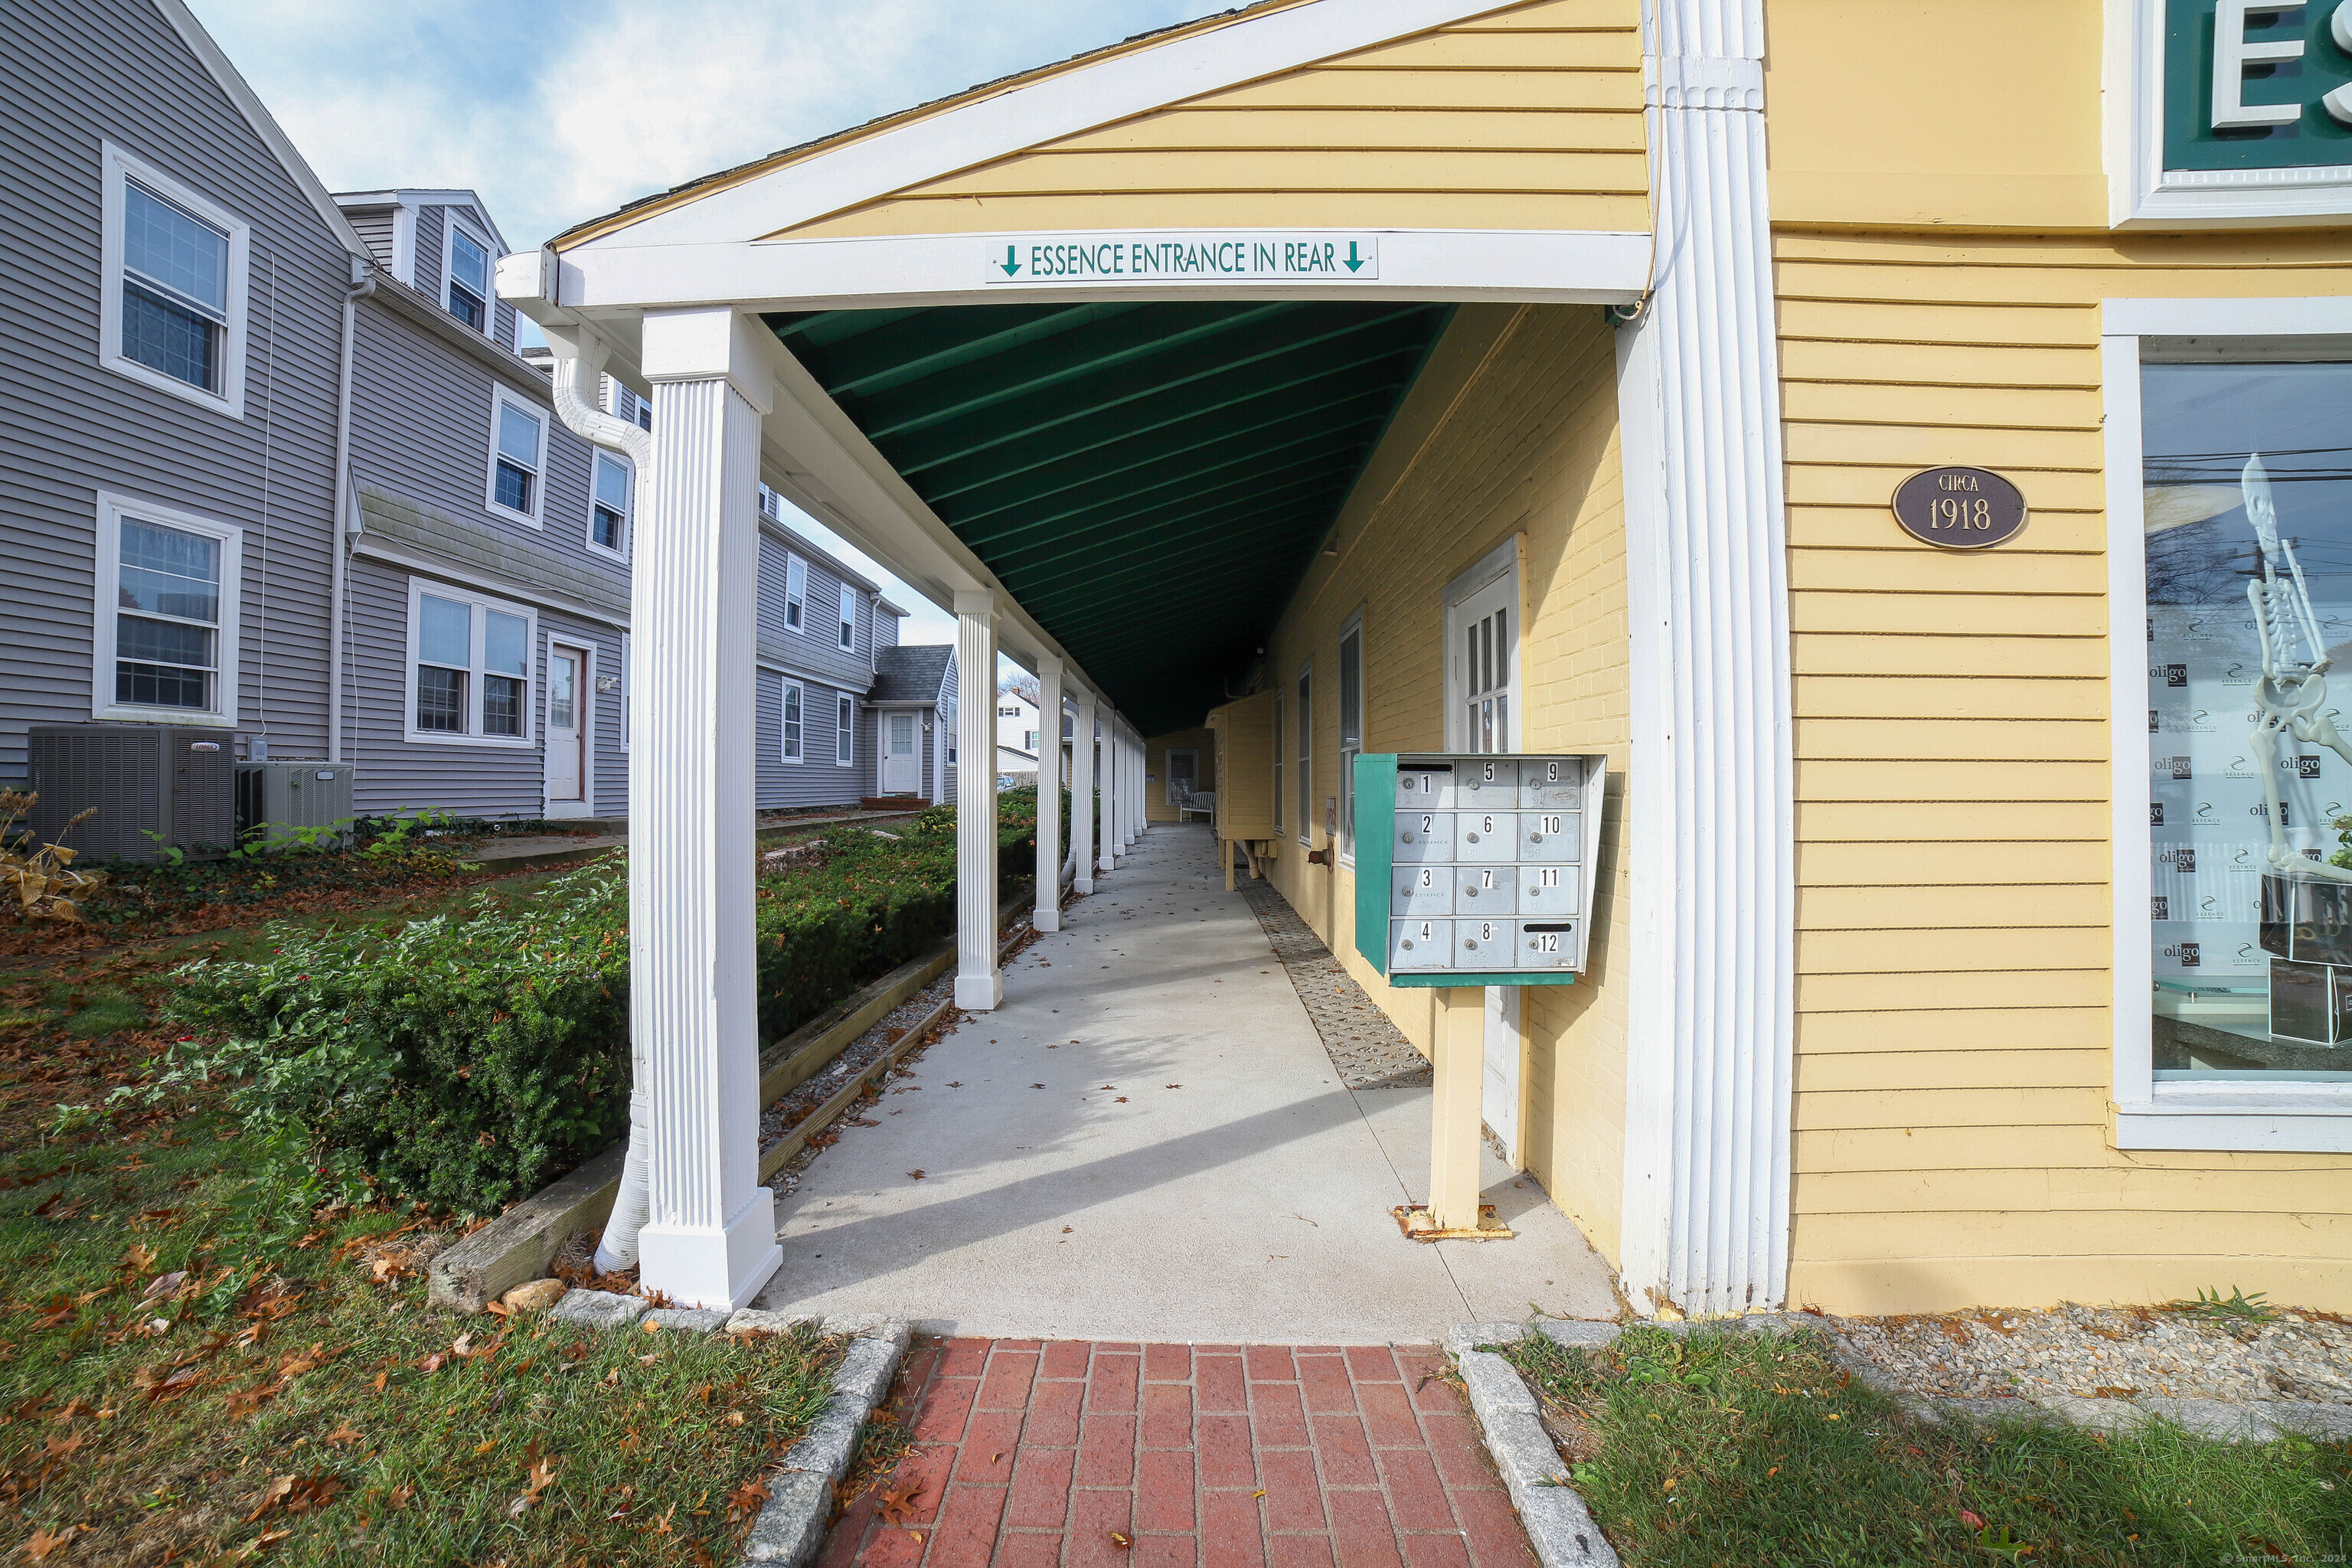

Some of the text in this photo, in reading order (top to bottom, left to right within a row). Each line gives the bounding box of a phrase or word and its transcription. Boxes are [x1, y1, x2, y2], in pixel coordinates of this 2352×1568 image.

[1031, 241, 1337, 276] ESSENCE ENTRANCE IN REAR
[1939, 474, 1979, 492] CIRCA
[1930, 498, 1991, 531] 1918
[2149, 665, 2187, 683] oligo
[1485, 763, 1493, 781] 5
[1549, 763, 1557, 781] 9
[2154, 757, 2191, 775] oligo
[2280, 756, 2320, 774] oligo
[1423, 775, 1429, 793] 1
[1423, 815, 1431, 833] 2
[1484, 815, 1492, 833] 6
[1544, 816, 1560, 834] 10
[2159, 851, 2196, 868] oligo
[1423, 869, 1431, 887] 3
[1484, 870, 1491, 887] 7
[1541, 868, 1557, 886] 11
[1423, 923, 1430, 940] 4
[1482, 923, 1491, 940] 8
[1540, 934, 1557, 952] 12
[2164, 944, 2200, 962] oligo
